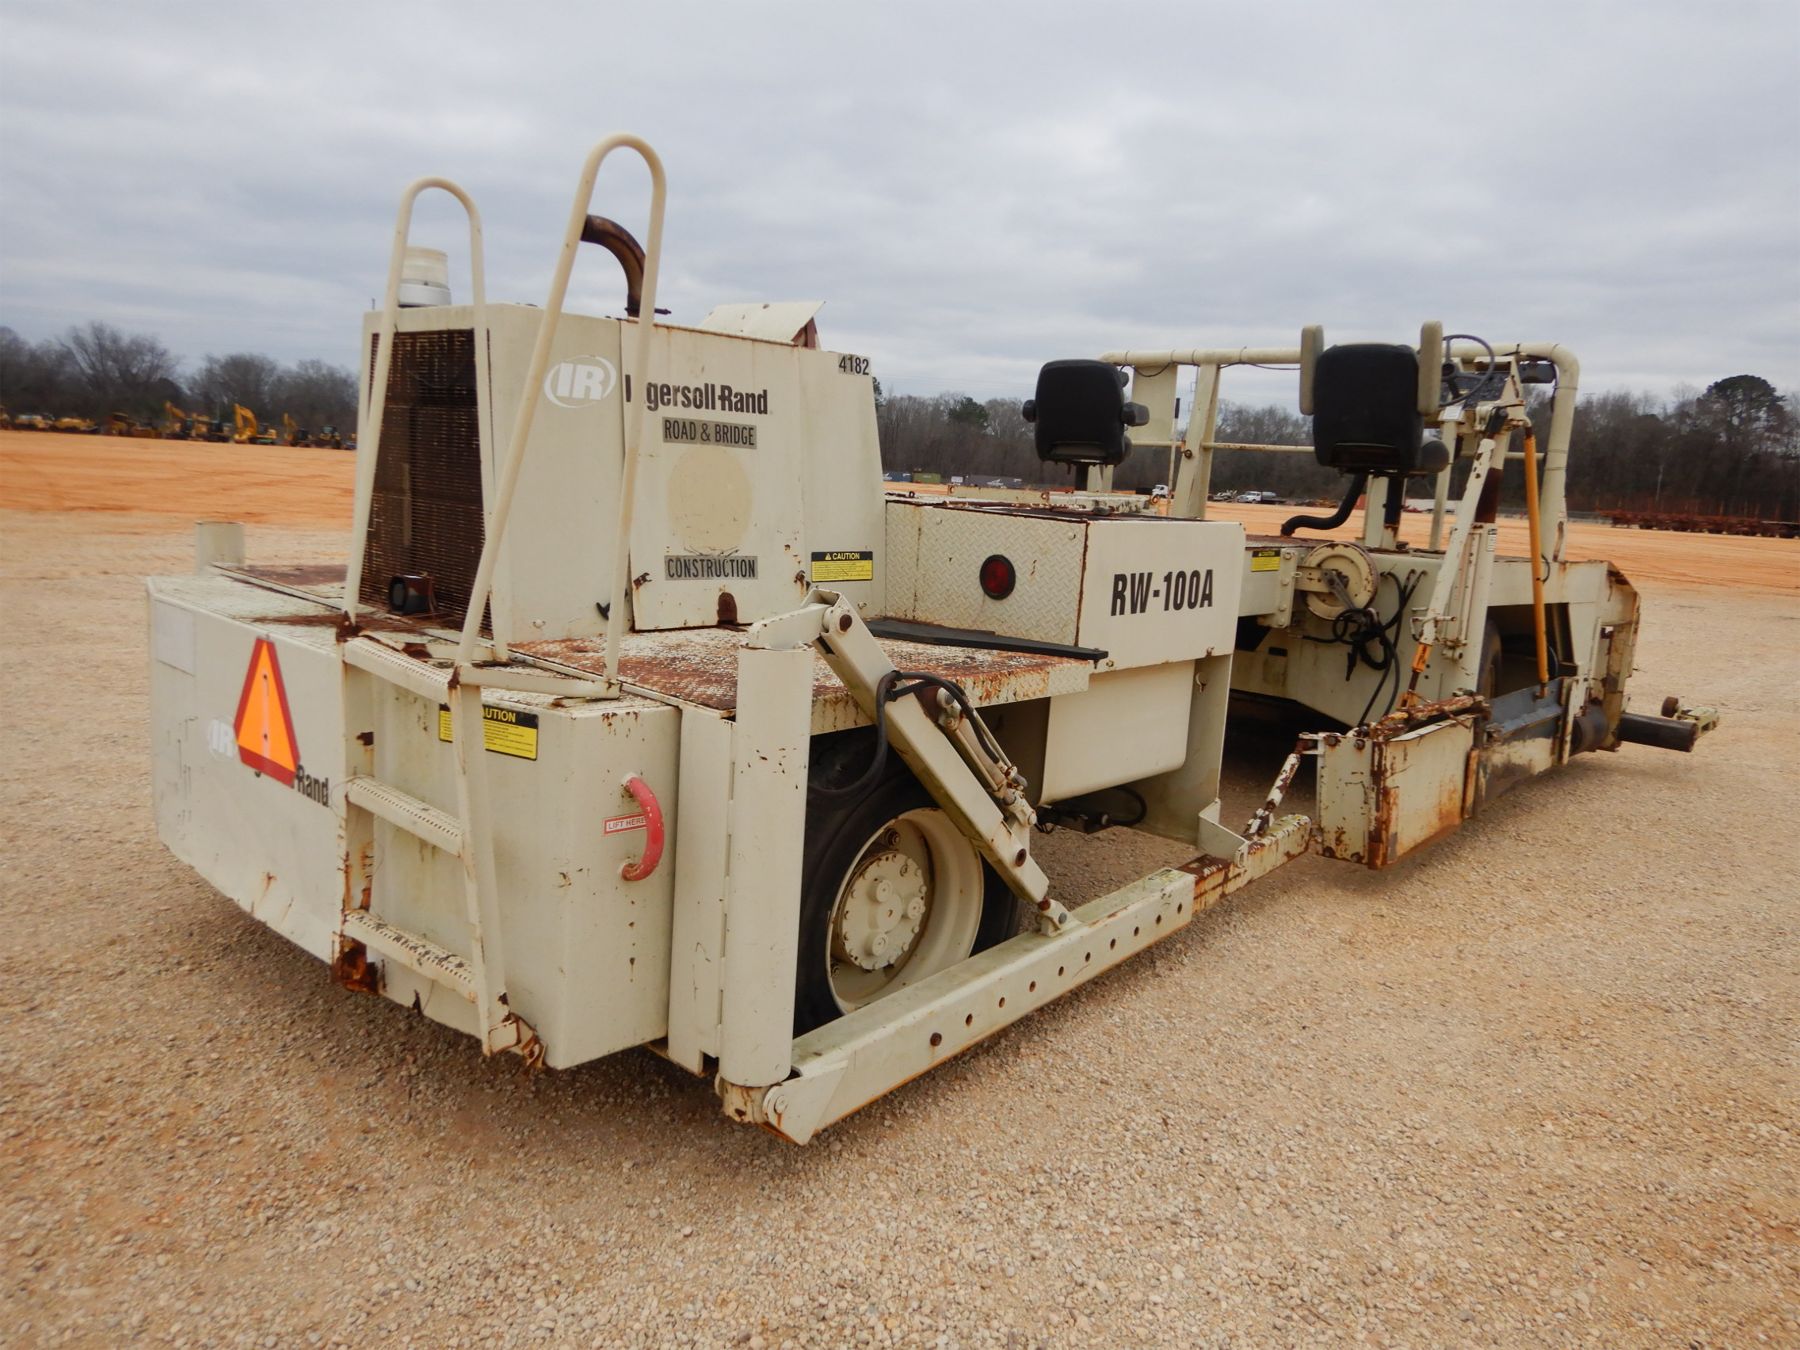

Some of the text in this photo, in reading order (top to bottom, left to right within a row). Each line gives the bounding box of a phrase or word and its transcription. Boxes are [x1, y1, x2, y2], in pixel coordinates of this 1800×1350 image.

[838, 355, 870, 375] 4182
[556, 362, 605, 400] IR
[625, 374, 768, 415] Igersoll-Rand
[664, 419, 755, 446] ROAD & BRIDGE
[832, 552, 860, 560] CAUTION
[667, 558, 756, 579] CONSTRUCTION
[1110, 569, 1213, 616] RW-100A
[483, 707, 516, 722] UTION
[608, 820, 625, 830] LIFT
